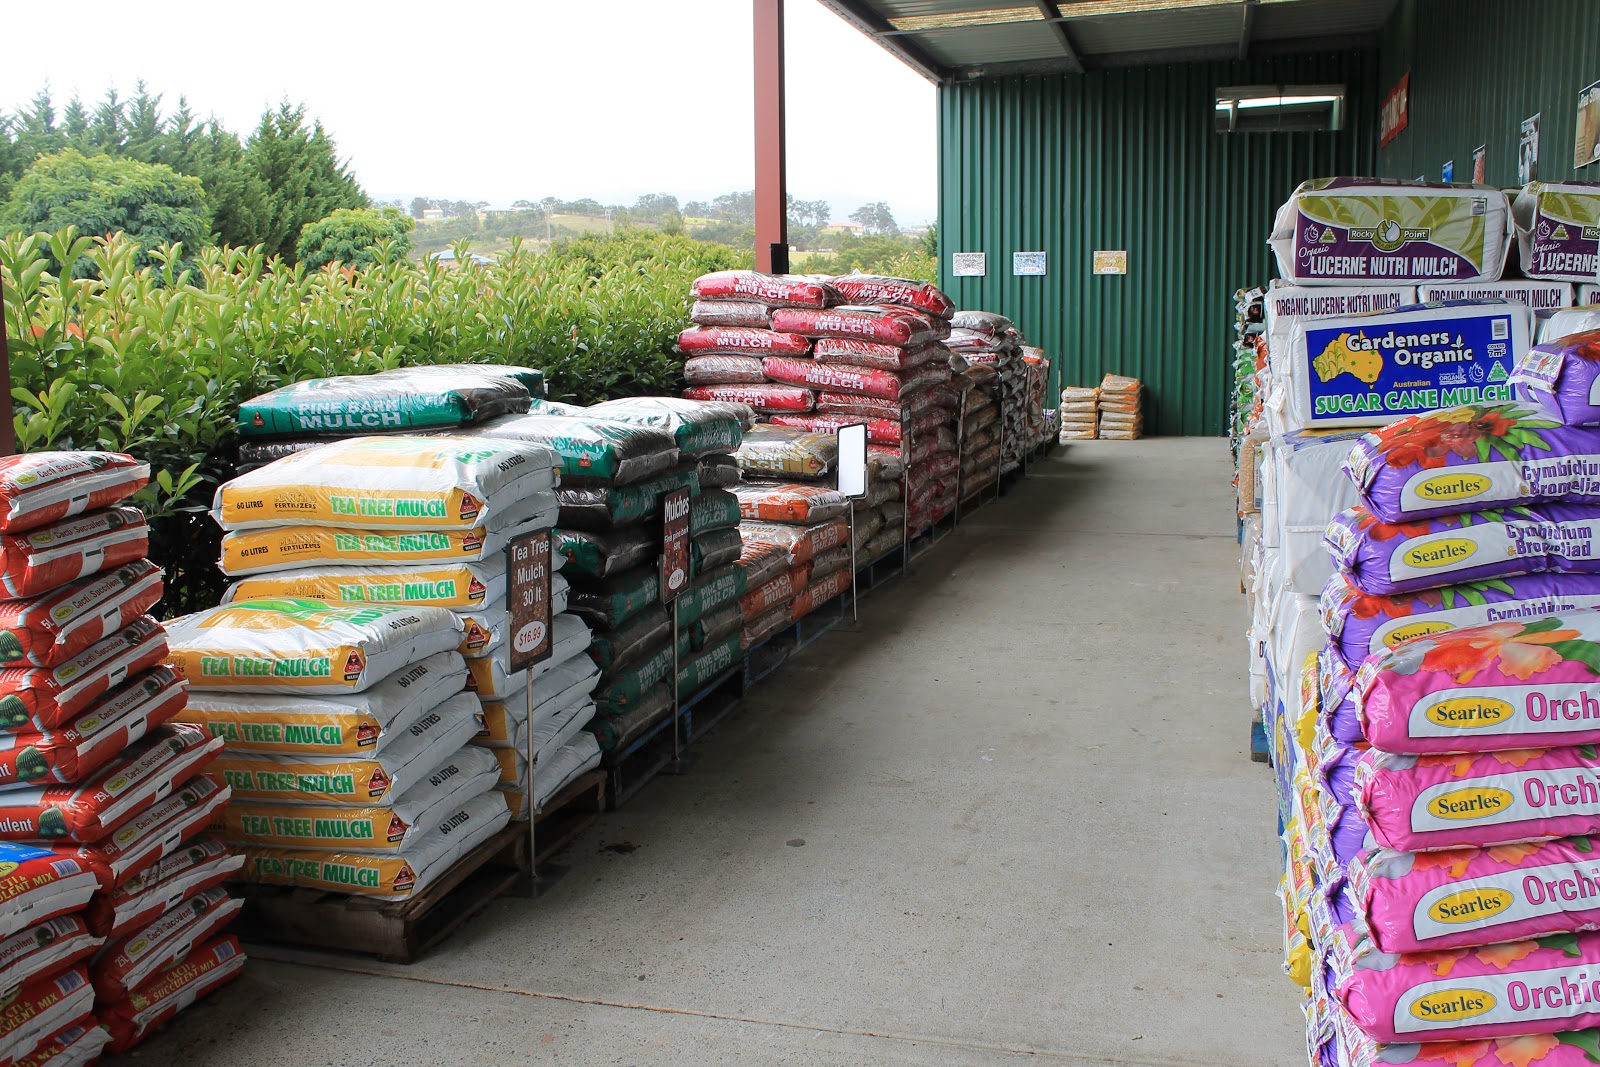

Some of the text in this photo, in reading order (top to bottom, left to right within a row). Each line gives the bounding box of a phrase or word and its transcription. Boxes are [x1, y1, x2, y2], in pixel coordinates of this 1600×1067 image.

[1351, 230, 1426, 239] Rocky Point
[1299, 244, 1330, 267] Organic
[1310, 256, 1458, 276] LUCERNE NUTRI MULCH
[735, 284, 789, 300] MULCH
[738, 278, 787, 291] RED CHIP
[864, 283, 884, 293] RED
[1276, 291, 1400, 317] ORGANIC LUCERNE NUTRI MULCH
[1531, 289, 1561, 307] MULCH
[815, 321, 875, 335] MULCH
[819, 315, 872, 326] RED CHIP
[716, 337, 772, 349] MULCH
[720, 331, 769, 342] RED CHIP
[1346, 331, 1450, 352] Gardeners
[1394, 348, 1473, 370] Organic
[805, 373, 864, 390] MULCH
[810, 367, 862, 381] RED CHIP
[1393, 380, 1431, 389] Australian
[299, 394, 458, 415] PINE BARK FINE
[1315, 384, 1511, 415] SUGAR CANE MULCH
[300, 411, 401, 429] MULCH
[816, 420, 838, 428] RED
[37, 467, 55, 477] Cacti
[498, 454, 526, 472] 60 LITRES
[1424, 460, 1600, 497] Searles Cymbidiu
[1521, 479, 1600, 496] & Bromelia
[245, 501, 263, 509] LITRES
[329, 496, 359, 516] TEA
[360, 497, 393, 516] TREE
[394, 498, 448, 518] MULCH
[275, 502, 317, 510] FERTILIZERS
[664, 495, 690, 523] Mulches
[54, 518, 107, 539] Cacti Succulent
[241, 533, 452, 557] 60 LITRES TEA TREE MULCH
[280, 543, 321, 552] FERTILIZERS
[464, 543, 481, 551] WARNING
[511, 539, 549, 562] Tea Tree
[1411, 524, 1592, 564] Searles Cymbidium
[1507, 540, 1591, 557] & Bromeliad
[517, 562, 544, 585] Mulch
[717, 574, 735, 589] BARK
[72, 578, 120, 609] Cacti Succulent
[339, 579, 457, 602] TEA TREE MULCH
[523, 588, 534, 607] 30
[701, 585, 736, 612] MULCH
[764, 584, 793, 607] MULCH
[811, 587, 839, 608] MULCH
[398, 615, 421, 628] LITRES
[519, 626, 541, 647] $16.99
[77, 638, 125, 668] Cacti Succulent
[696, 642, 731, 672] PINE BARK
[201, 657, 231, 676] TEA
[233, 657, 273, 677] TREE
[273, 657, 332, 678] MULCH
[638, 645, 674, 684] PINE BARK
[697, 654, 732, 684] MULCH
[397, 664, 429, 689] 60 LITRES
[99, 688, 145, 721] Cacti Succulent
[1436, 691, 1600, 722] Searles Orch
[208, 721, 344, 747] TEA TREE MULCH
[410, 713, 441, 737] 60 LITRES
[125, 746, 170, 780] Cacti Succulent
[224, 770, 356, 795] TEA TREE MULCH
[429, 764, 460, 788] 60 LITRES
[135, 799, 184, 830] Cacti Succulent
[1438, 795, 1501, 815] Searles
[241, 815, 374, 839] TEA TREE MULCH
[439, 811, 470, 836] 60 LITRES
[32, 872, 55, 887] MIX
[253, 856, 381, 889] TEA TREE MULCH
[1438, 868, 1600, 919] Searles Orchi
[147, 907, 193, 942] Cacti Succulent
[115, 955, 129, 968] 25L
[153, 969, 199, 1000] SUCCULENT
[199, 959, 216, 973] MIX
[167, 963, 191, 983] CACTI
[38, 992, 59, 1010] MIX
[1420, 997, 1484, 1017] Searles
